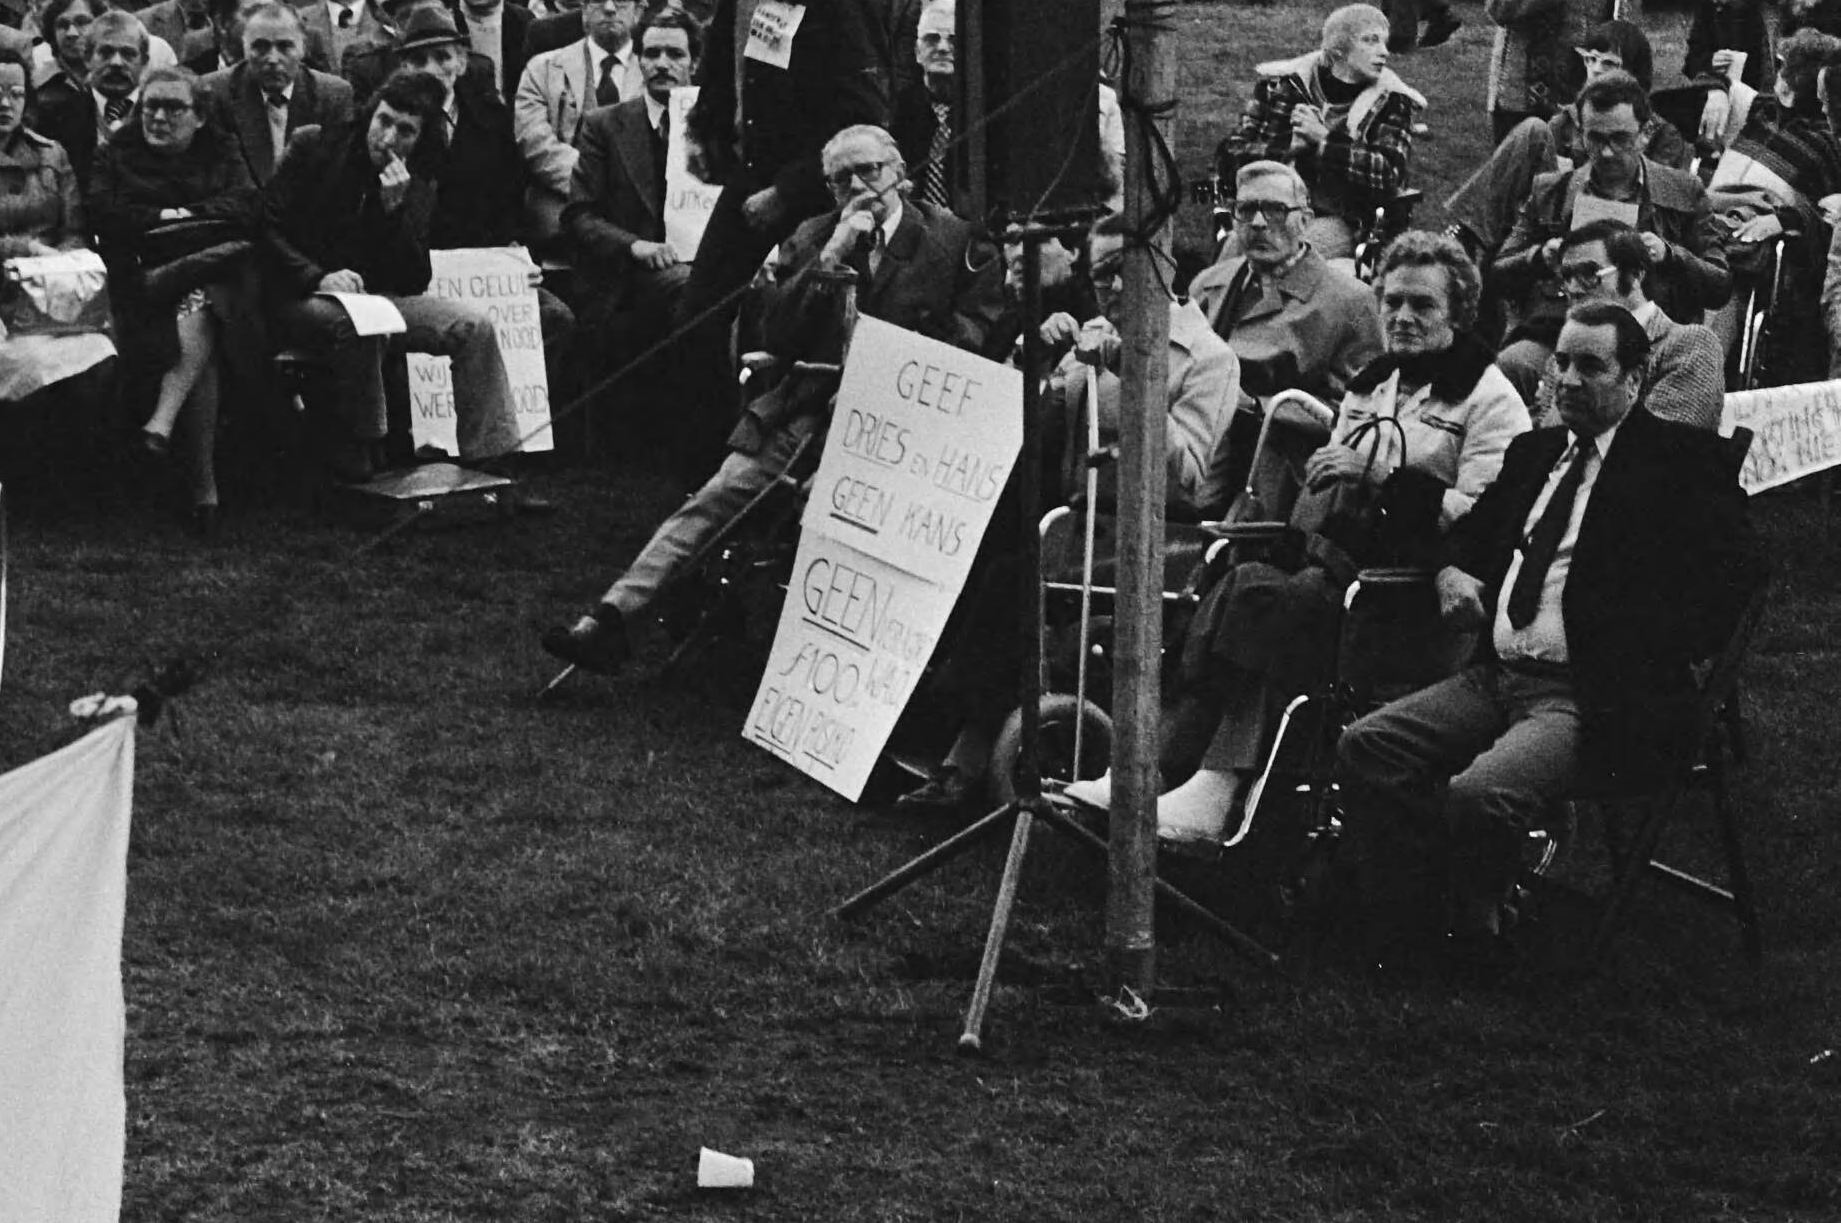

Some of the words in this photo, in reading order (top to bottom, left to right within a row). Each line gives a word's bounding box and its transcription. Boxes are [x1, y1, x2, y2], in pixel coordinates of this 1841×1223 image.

[486, 304, 534, 324] OVER
[499, 327, 544, 350] NOOD
[896, 359, 983, 418] GEEF
[842, 408, 911, 466] DRIES
[931, 442, 1004, 502] HANS
[831, 475, 896, 528] GEEN
[899, 499, 968, 557] KANS
[803, 557, 895, 642] GEEN
